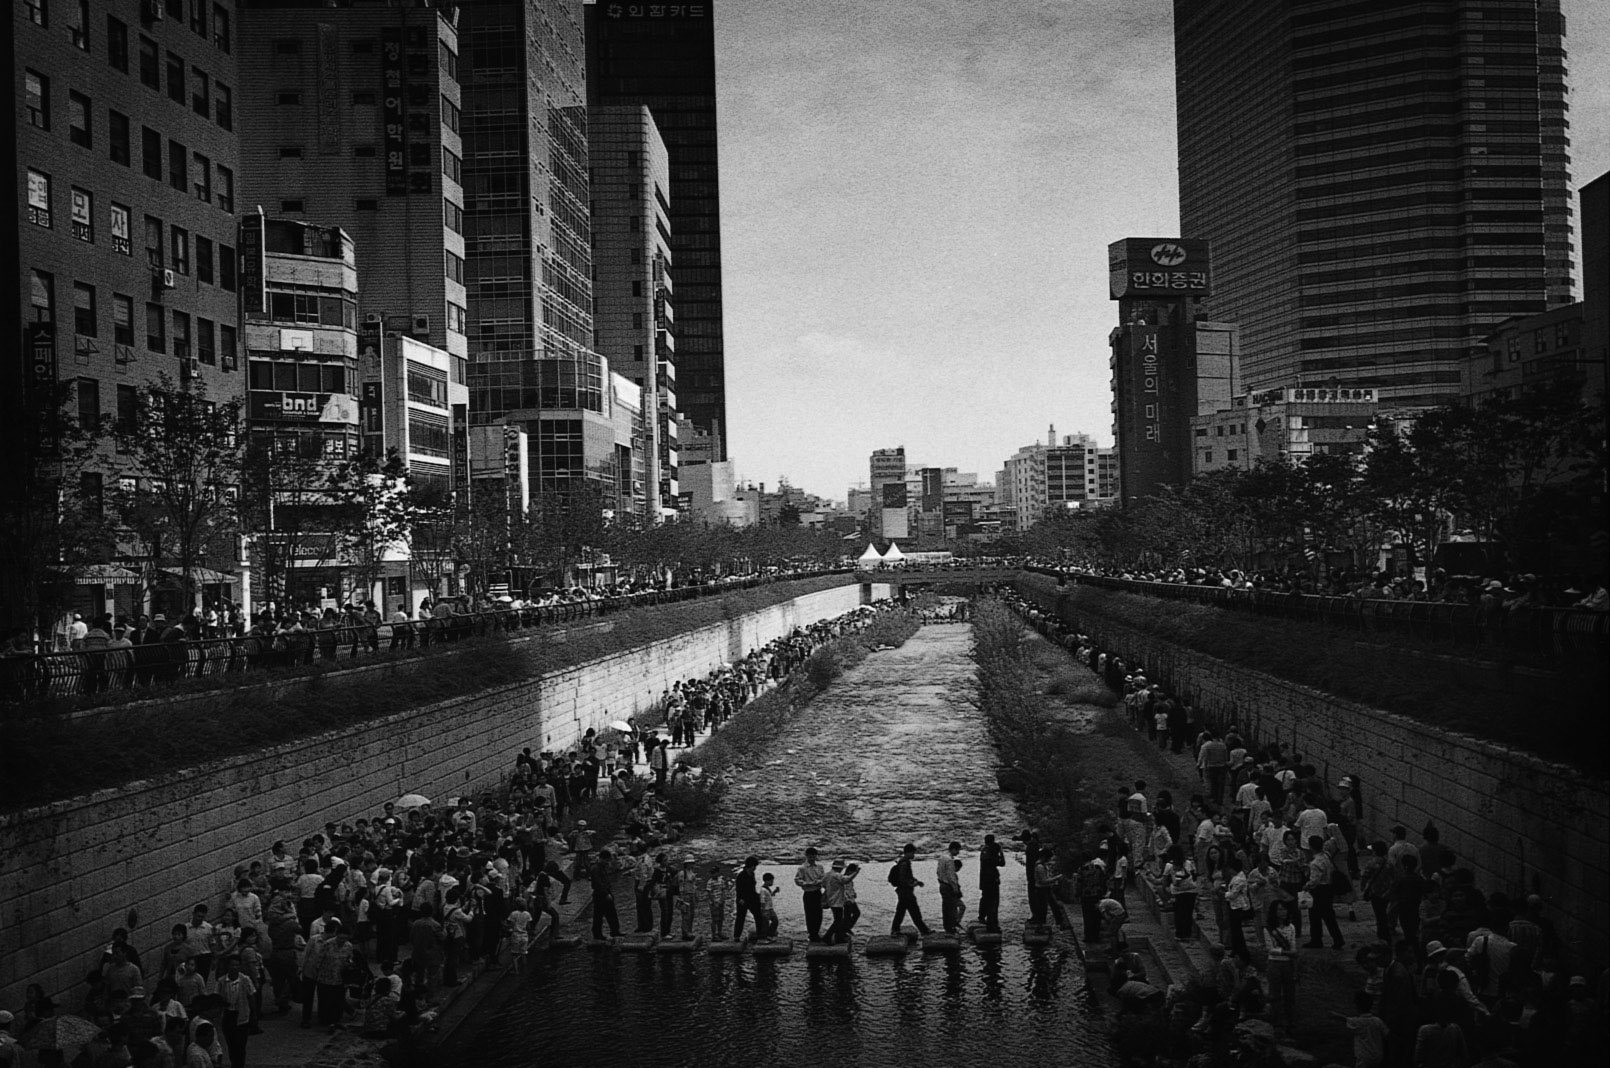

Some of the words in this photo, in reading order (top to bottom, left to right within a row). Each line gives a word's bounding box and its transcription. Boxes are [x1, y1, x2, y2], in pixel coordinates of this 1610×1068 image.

[628, 4, 705, 17] 외환카드
[384, 42, 404, 170] 정철어학원
[1132, 271, 1206, 289] 한화증권
[1142, 333, 1159, 397] 서울의
[282, 393, 317, 411] bnd
[1145, 402, 1160, 443] 미래
